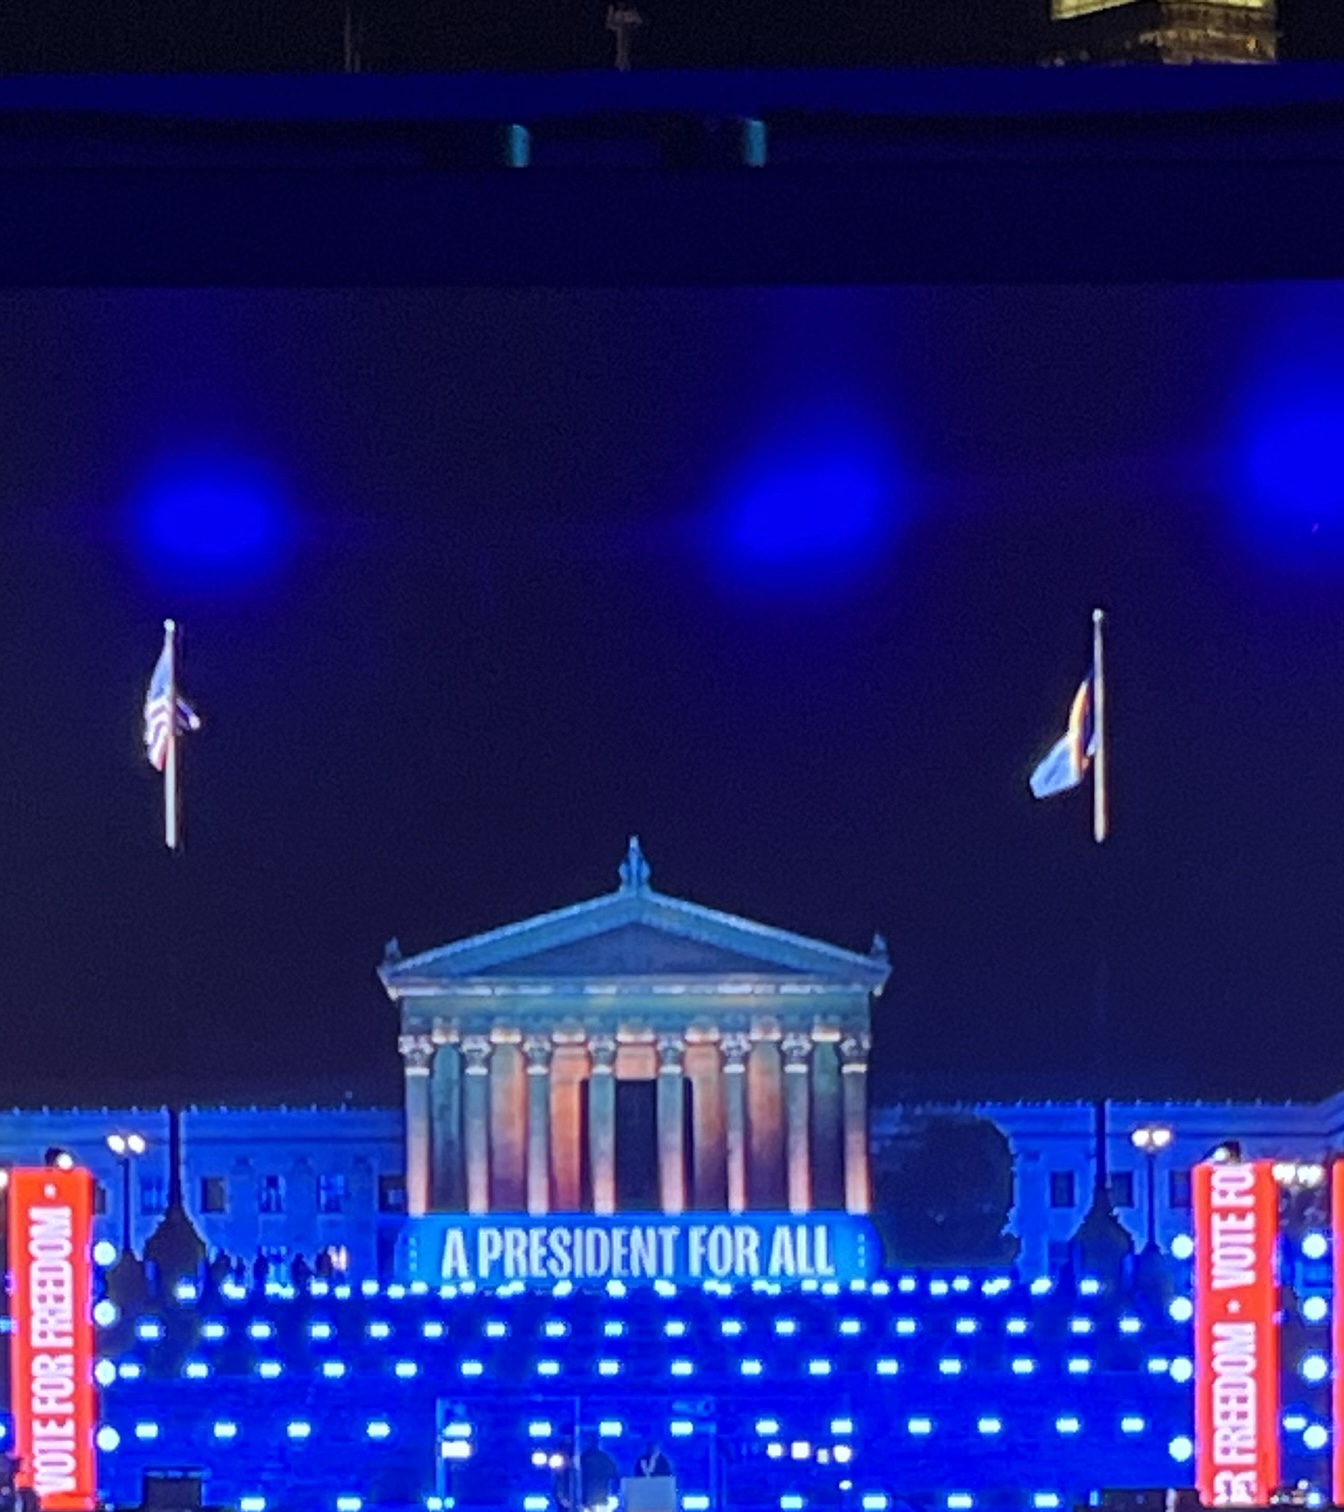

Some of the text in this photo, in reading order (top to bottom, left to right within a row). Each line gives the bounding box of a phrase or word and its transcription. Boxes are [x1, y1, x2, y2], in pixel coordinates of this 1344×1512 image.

[1210, 1163, 1255, 1207] FO
[442, 1225, 834, 1278] A PRESIDENT FOR ALL
[1211, 1213, 1256, 1290] VOTE
[29, 1206, 76, 1496] VOTE FOR FREEDOM
[1212, 1322, 1256, 1465] FREEDOM
